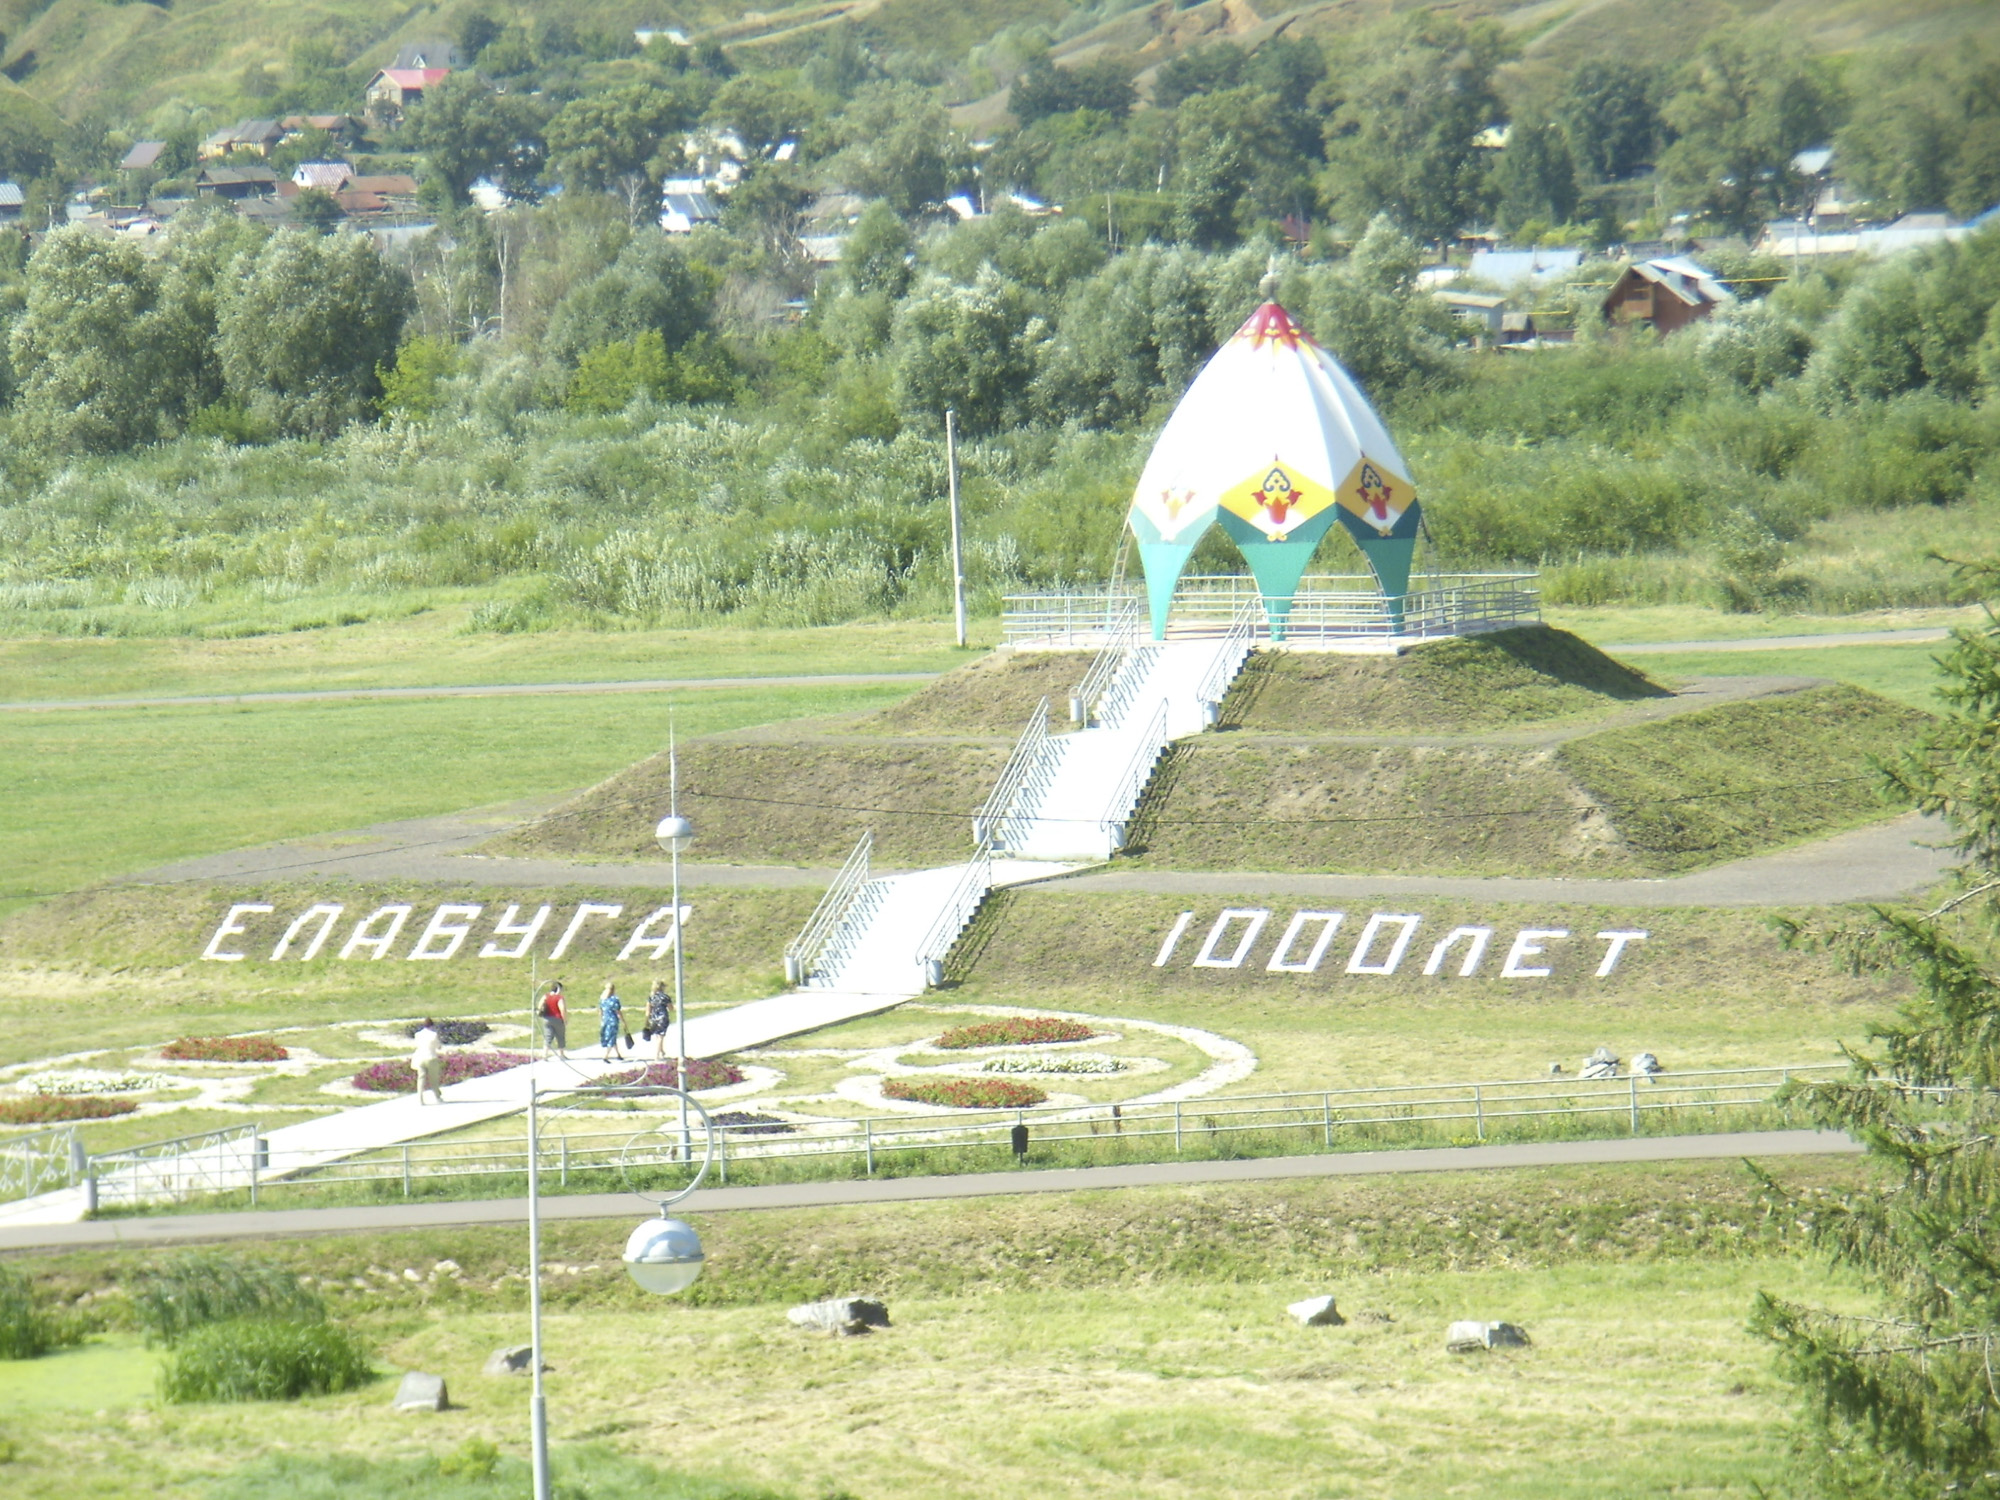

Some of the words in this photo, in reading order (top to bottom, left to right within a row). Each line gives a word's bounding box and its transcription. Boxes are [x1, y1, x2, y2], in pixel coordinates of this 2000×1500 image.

[200, 904, 693, 961] ЕЛАБУГА
[1151, 908, 1421, 975] 1000
[1422, 926, 1650, 978] ЛЕТ
